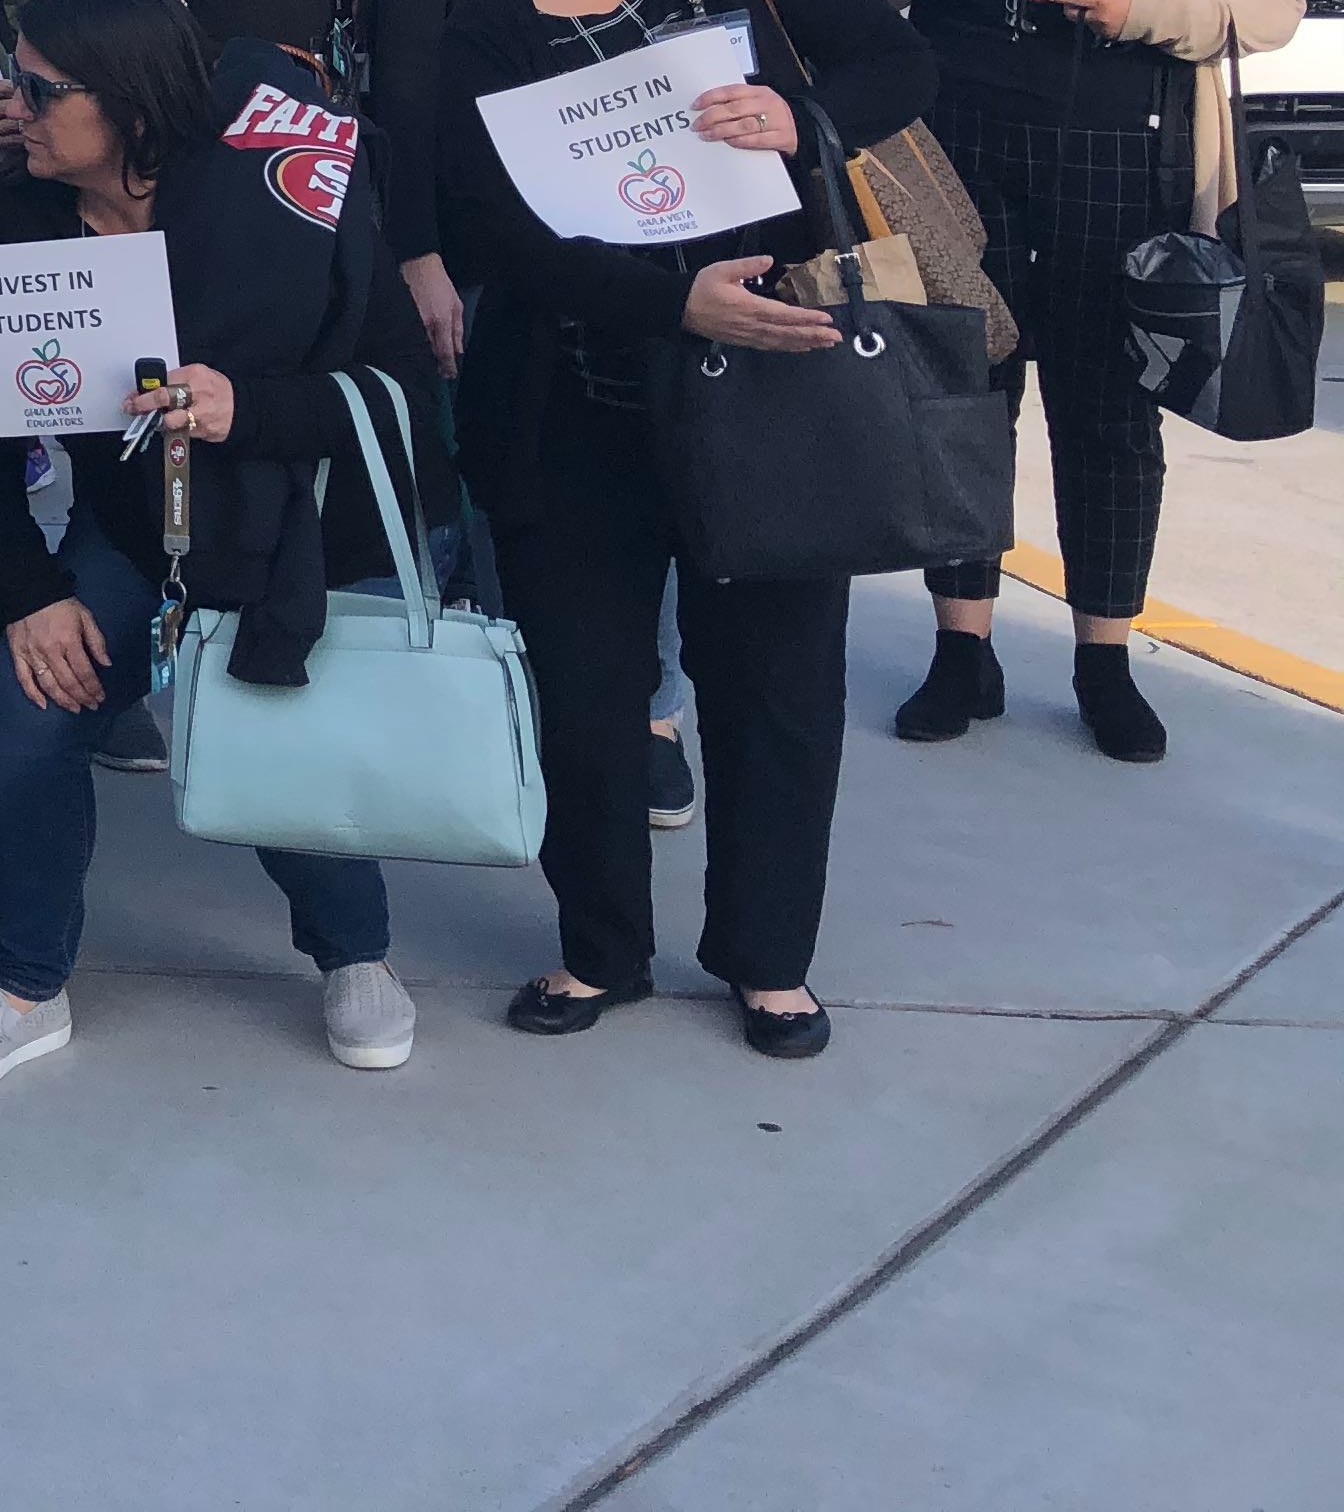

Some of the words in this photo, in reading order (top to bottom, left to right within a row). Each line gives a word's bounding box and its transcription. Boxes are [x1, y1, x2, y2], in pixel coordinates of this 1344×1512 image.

[558, 85, 638, 125] INVEST
[645, 74, 672, 99] IN
[568, 110, 690, 160] STUDENTS
[69, 270, 94, 290] IN
